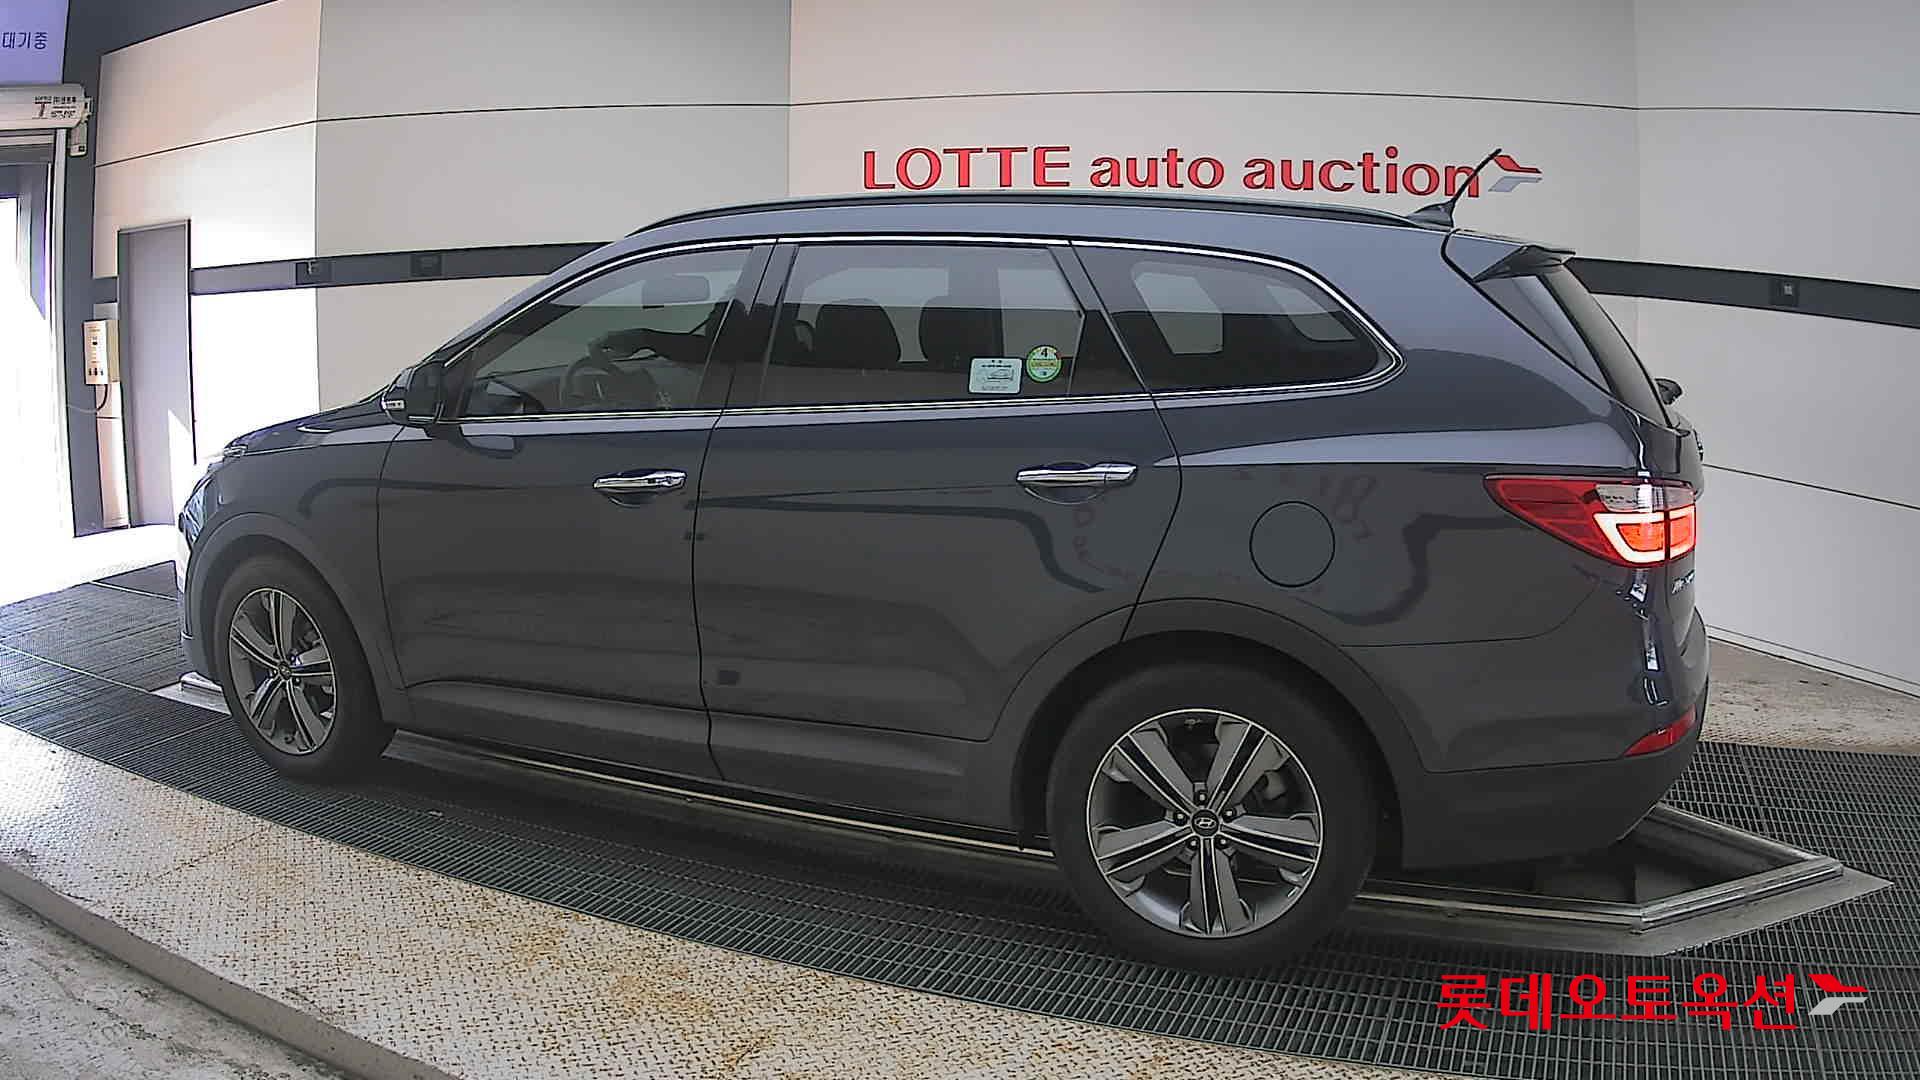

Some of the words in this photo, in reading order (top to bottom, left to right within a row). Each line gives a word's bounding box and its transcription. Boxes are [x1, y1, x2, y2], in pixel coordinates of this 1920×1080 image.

[2, 31, 48, 50] 대기중
[863, 146, 1071, 190] LOTTE
[1089, 148, 1226, 188] auto
[1242, 145, 1481, 198] auction
